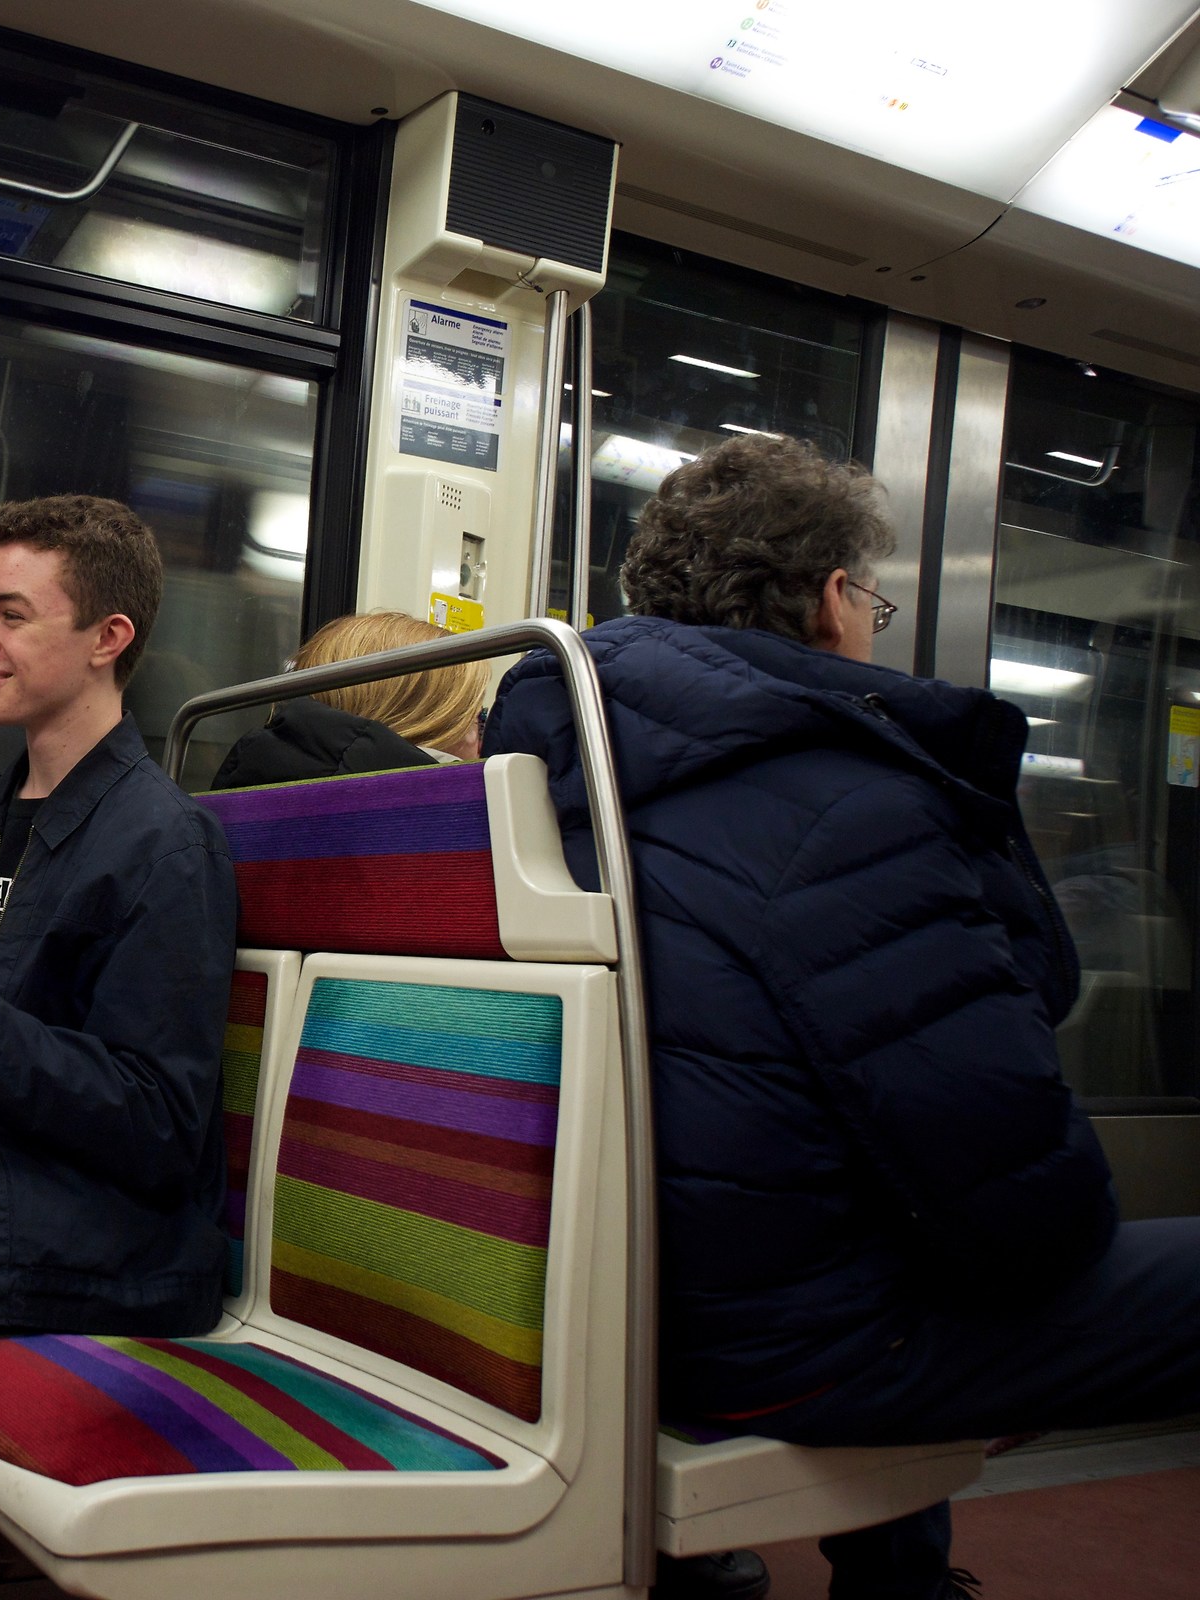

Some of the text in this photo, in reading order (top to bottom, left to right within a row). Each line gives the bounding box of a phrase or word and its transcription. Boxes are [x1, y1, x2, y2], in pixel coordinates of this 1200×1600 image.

[431, 315, 461, 329] Alarme
[472, 324, 492, 333] Emergency
[425, 394, 461, 410] Freinage
[424, 406, 459, 420] puissant
